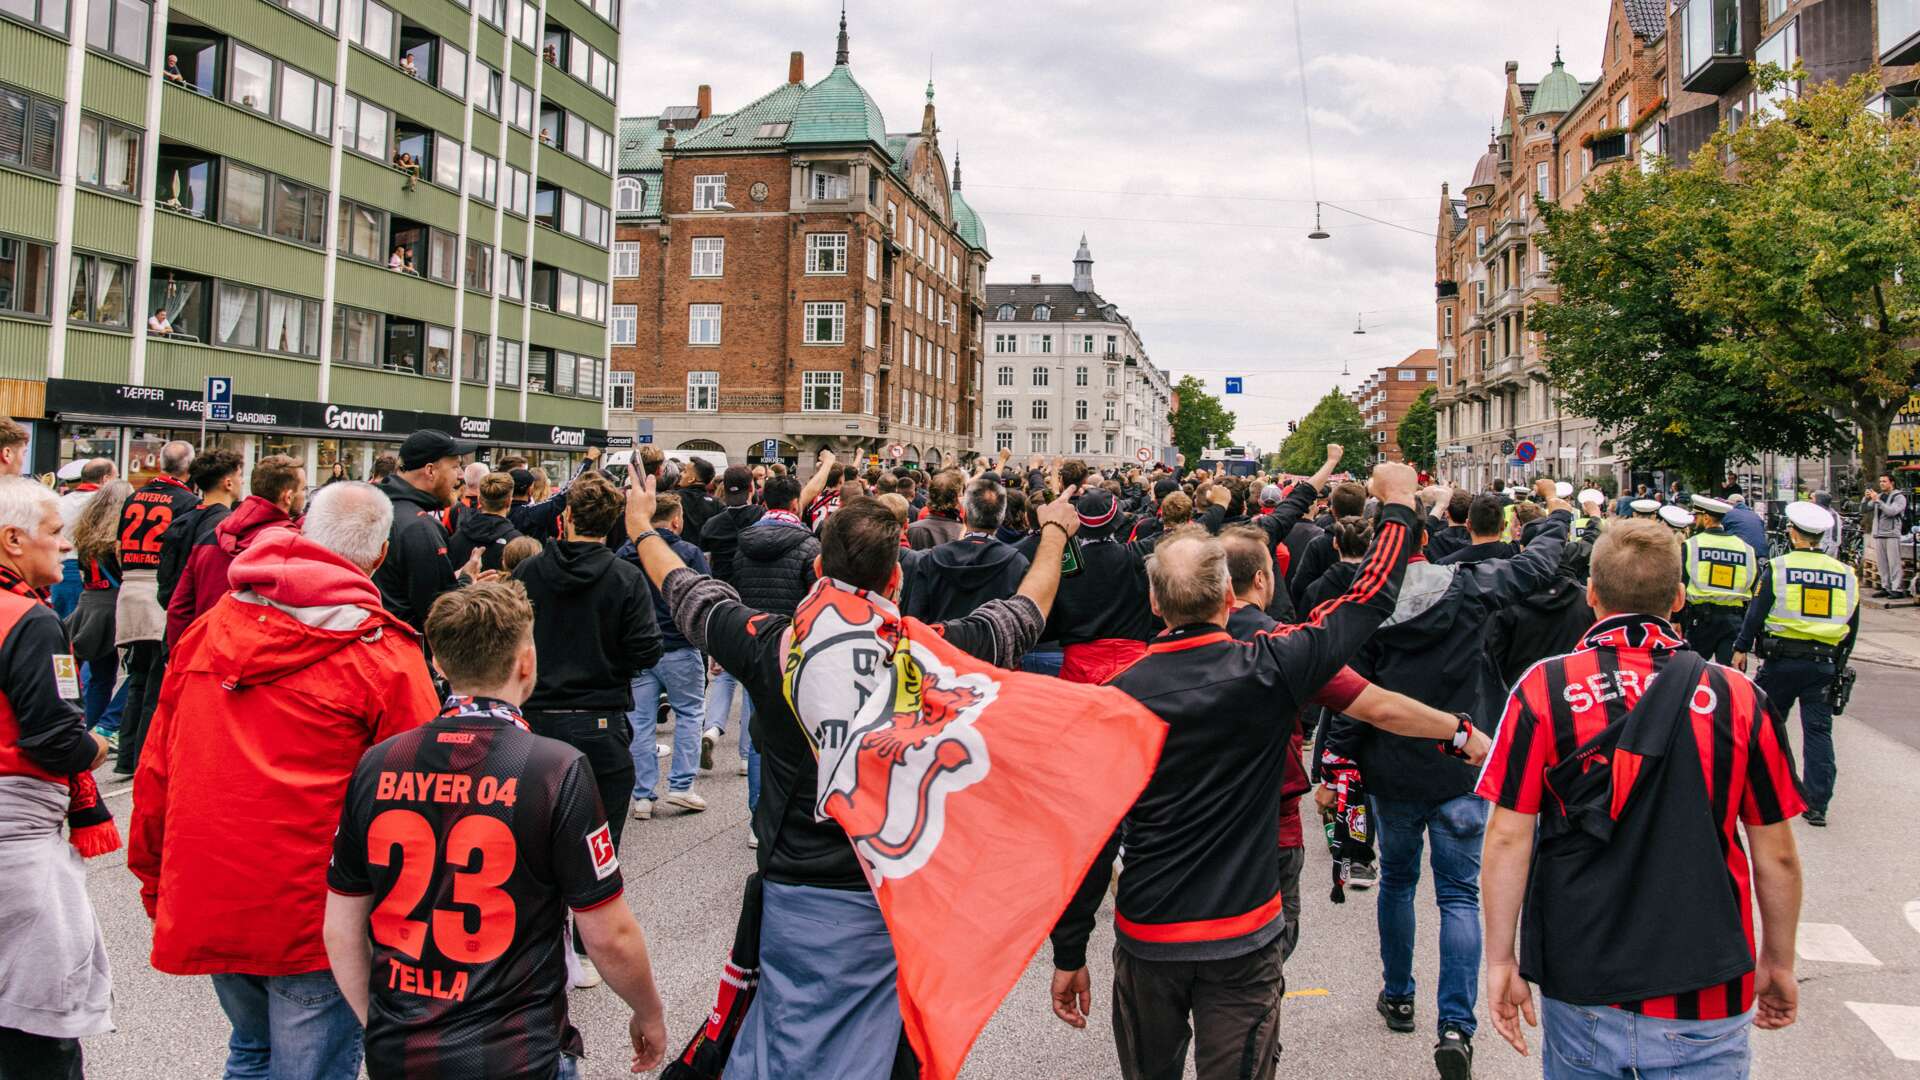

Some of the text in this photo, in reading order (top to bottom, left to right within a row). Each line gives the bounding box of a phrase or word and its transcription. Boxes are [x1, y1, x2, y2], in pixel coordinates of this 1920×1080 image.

[122, 386, 164, 401] TÆPPER
[212, 379, 226, 400] P
[176, 400, 205, 412] TRÆG
[236, 412, 277, 425] GARDINER
[325, 405, 384, 432] Garant
[460, 416, 491, 433] Garant
[551, 426, 585, 446] Garant
[767, 440, 775, 450] P
[121, 503, 173, 552] 22
[123, 552, 160, 565] BONIFAC
[1701, 550, 1744, 564] POLITI
[1789, 570, 1844, 588] POLITI
[376, 771, 518, 807] BAYER 04
[367, 809, 517, 964] 23
[388, 957, 469, 1002] TELLA
